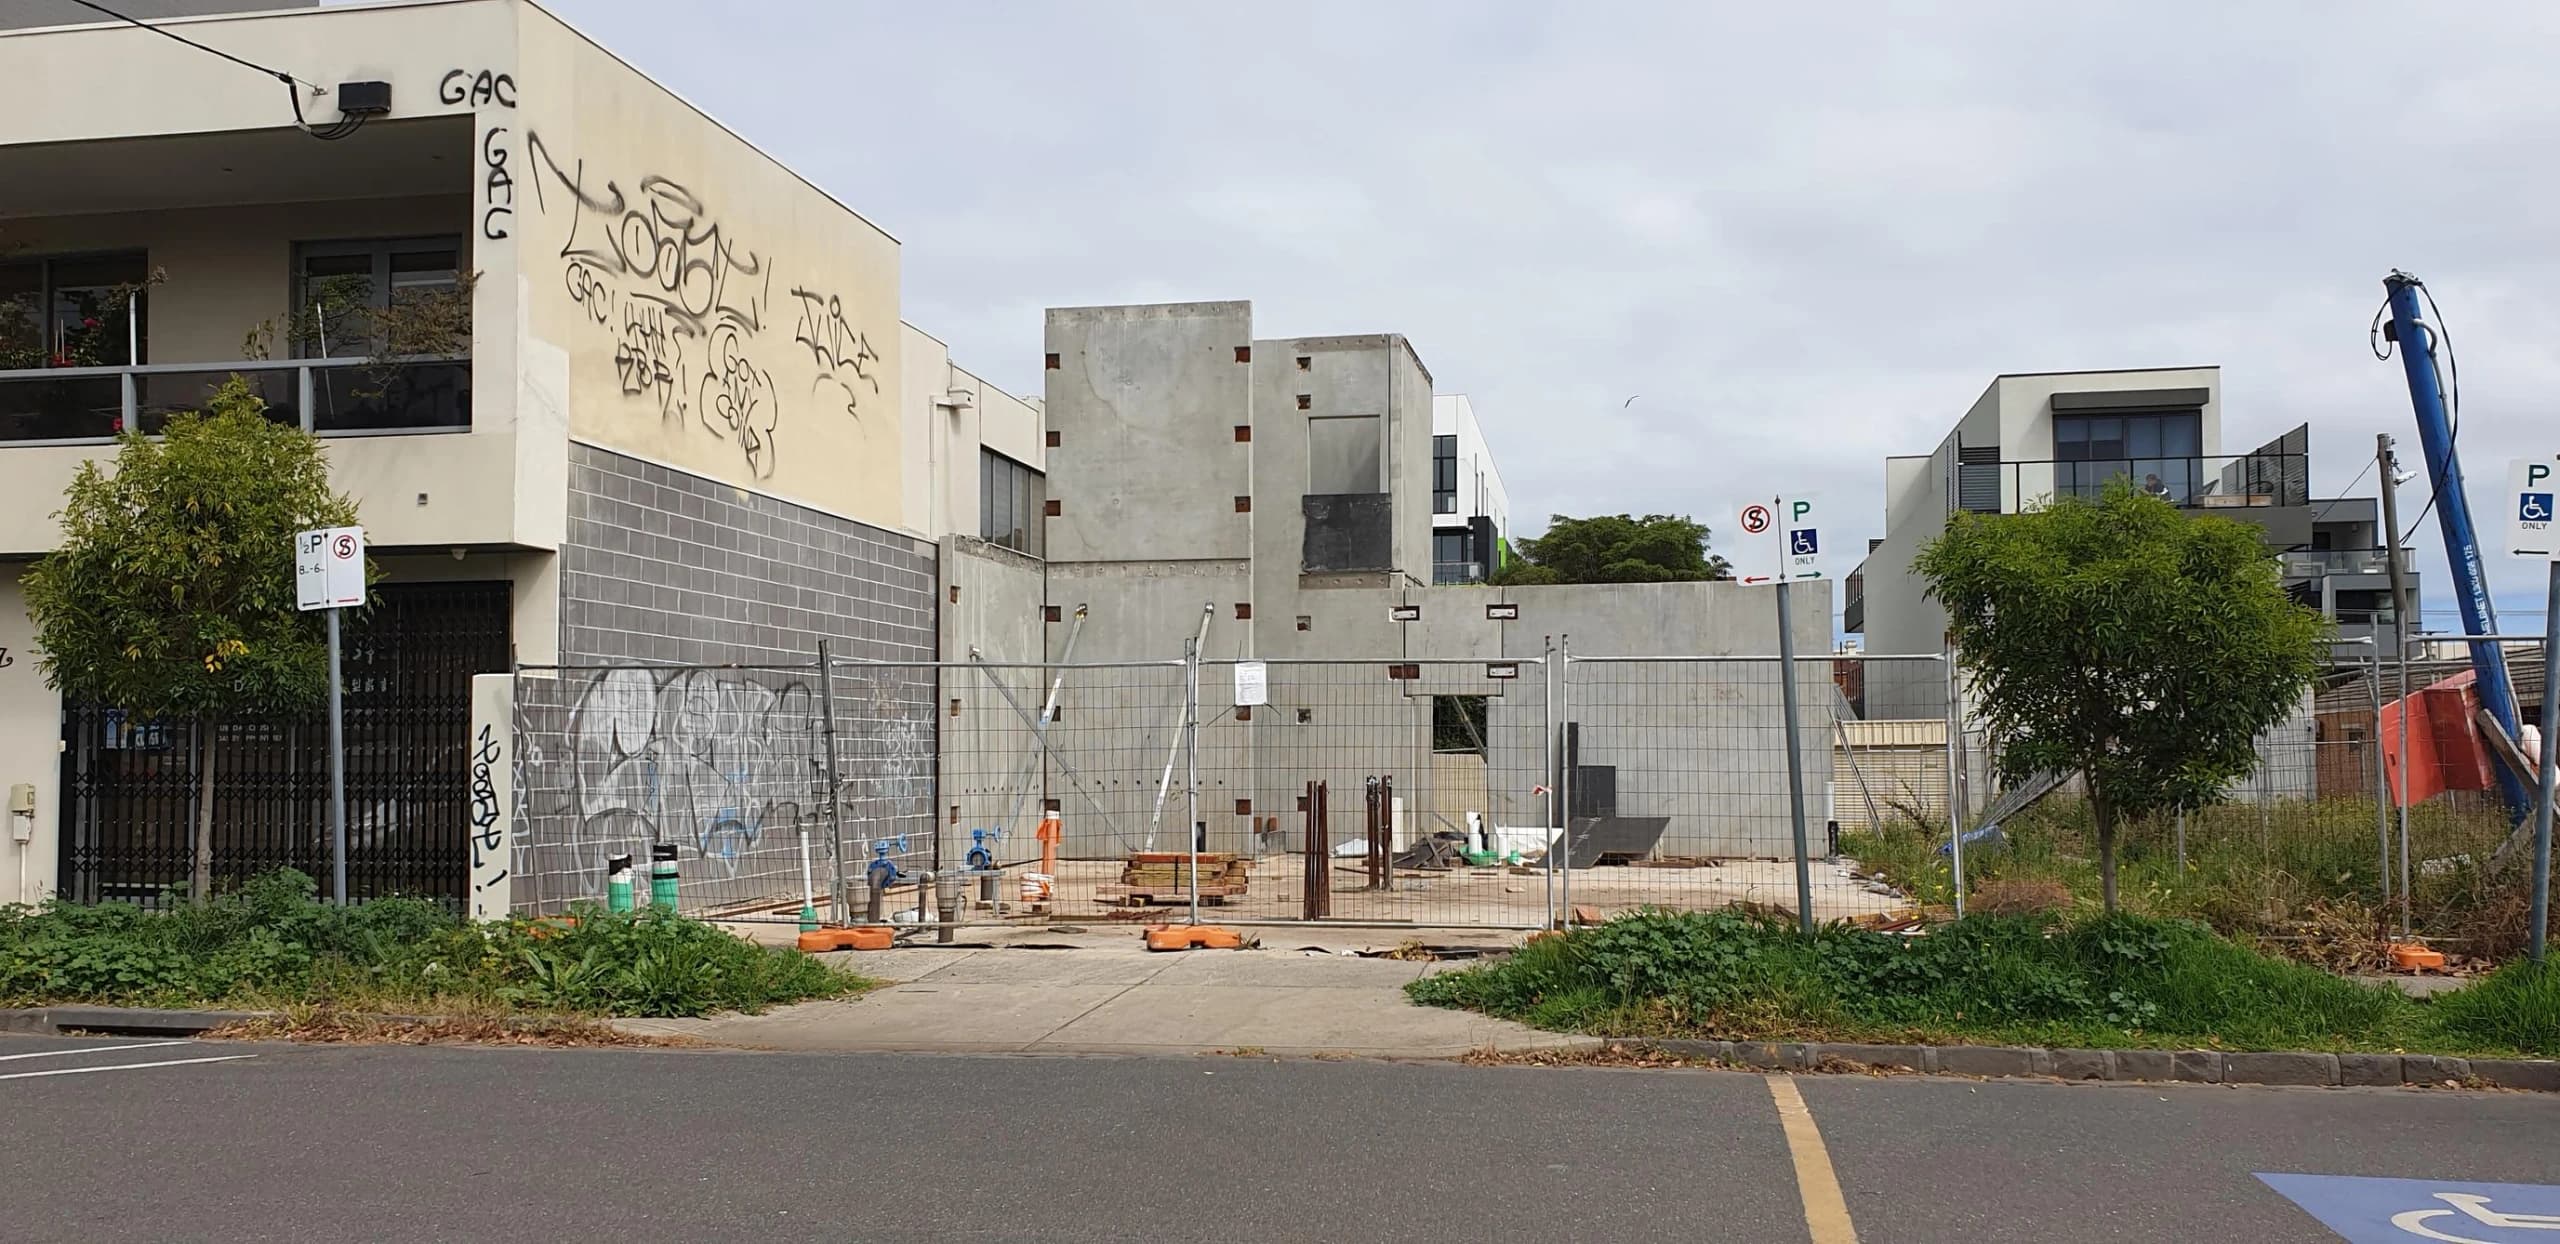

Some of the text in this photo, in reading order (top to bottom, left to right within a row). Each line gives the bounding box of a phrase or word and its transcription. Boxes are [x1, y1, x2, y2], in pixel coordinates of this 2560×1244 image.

[440, 69, 516, 108] GAC
[2528, 464, 2550, 487] P
[1793, 501, 1810, 521] P
[2521, 521, 2547, 530] ONLY
[1795, 557, 1815, 565] ONLY
